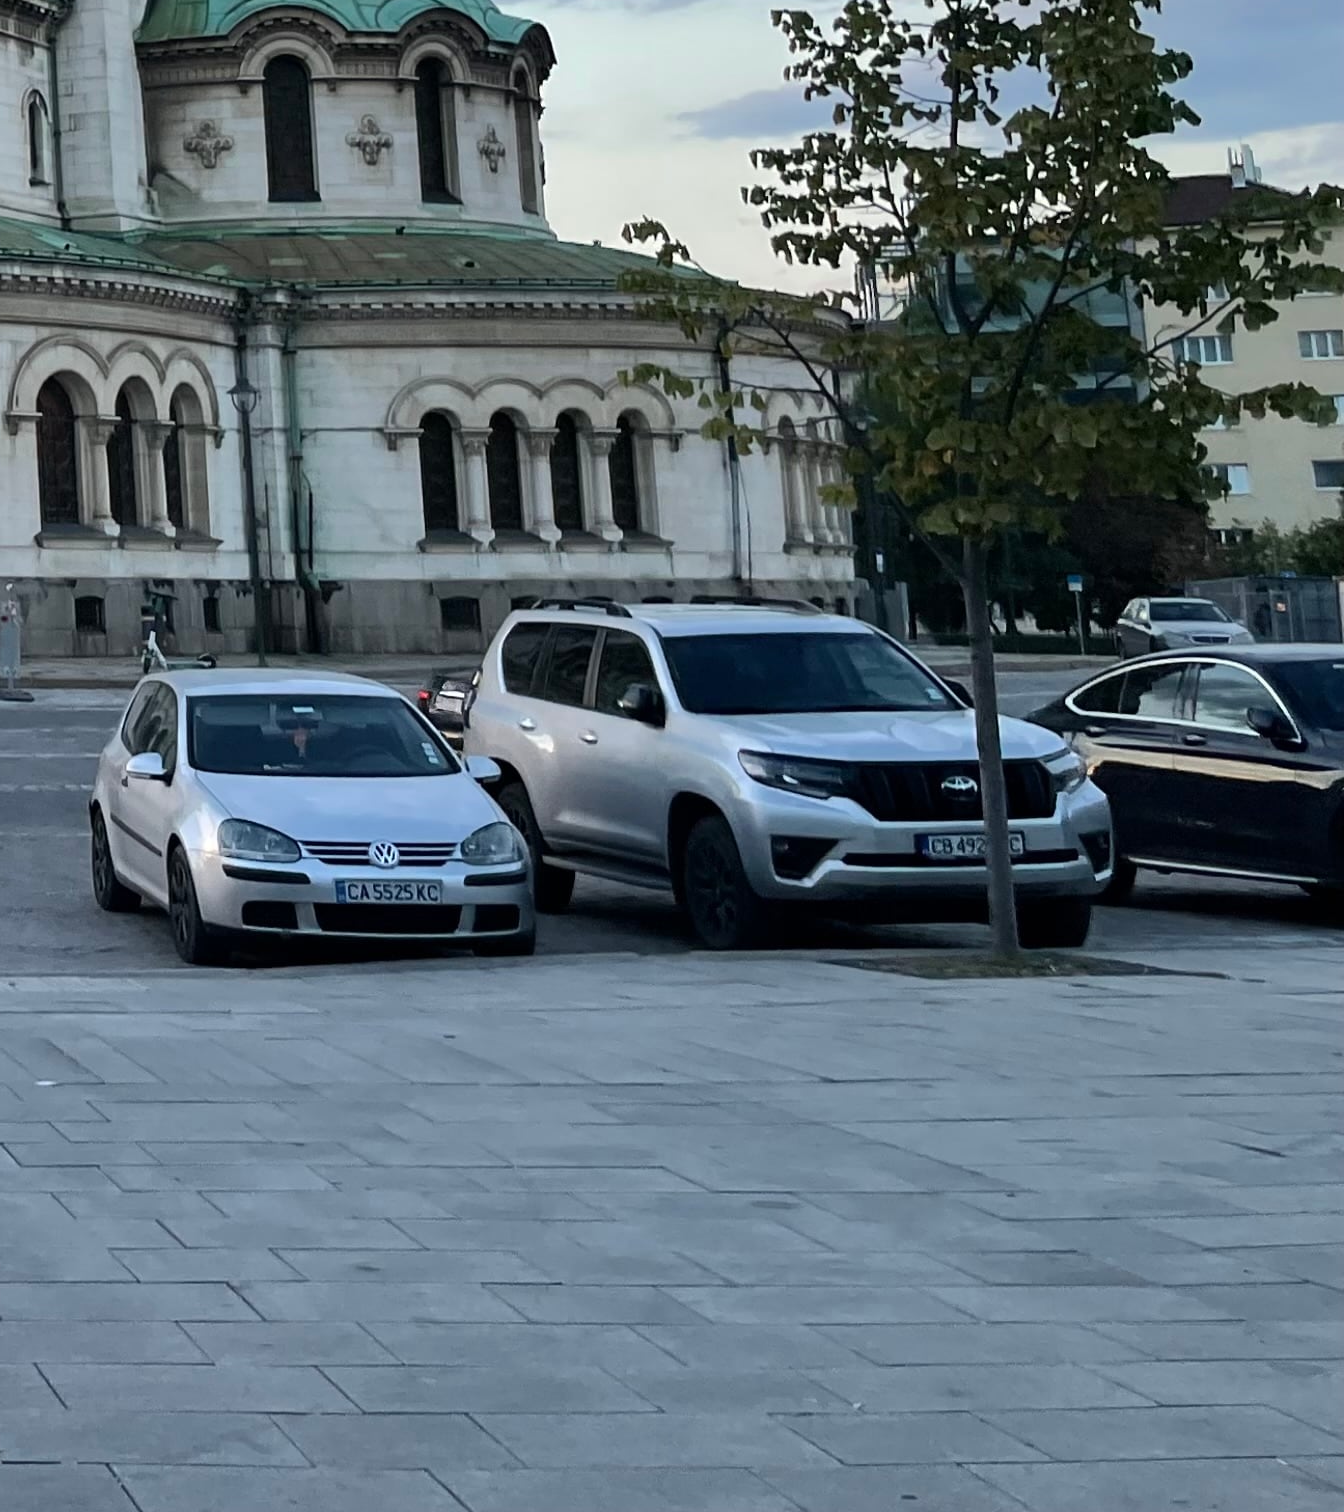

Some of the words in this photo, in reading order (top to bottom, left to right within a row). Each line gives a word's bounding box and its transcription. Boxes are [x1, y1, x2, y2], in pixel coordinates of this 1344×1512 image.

[931, 838, 953, 854] CB
[956, 836, 989, 854] 492
[347, 883, 370, 901] CA
[372, 883, 414, 901] 5525
[415, 884, 439, 902] KC
